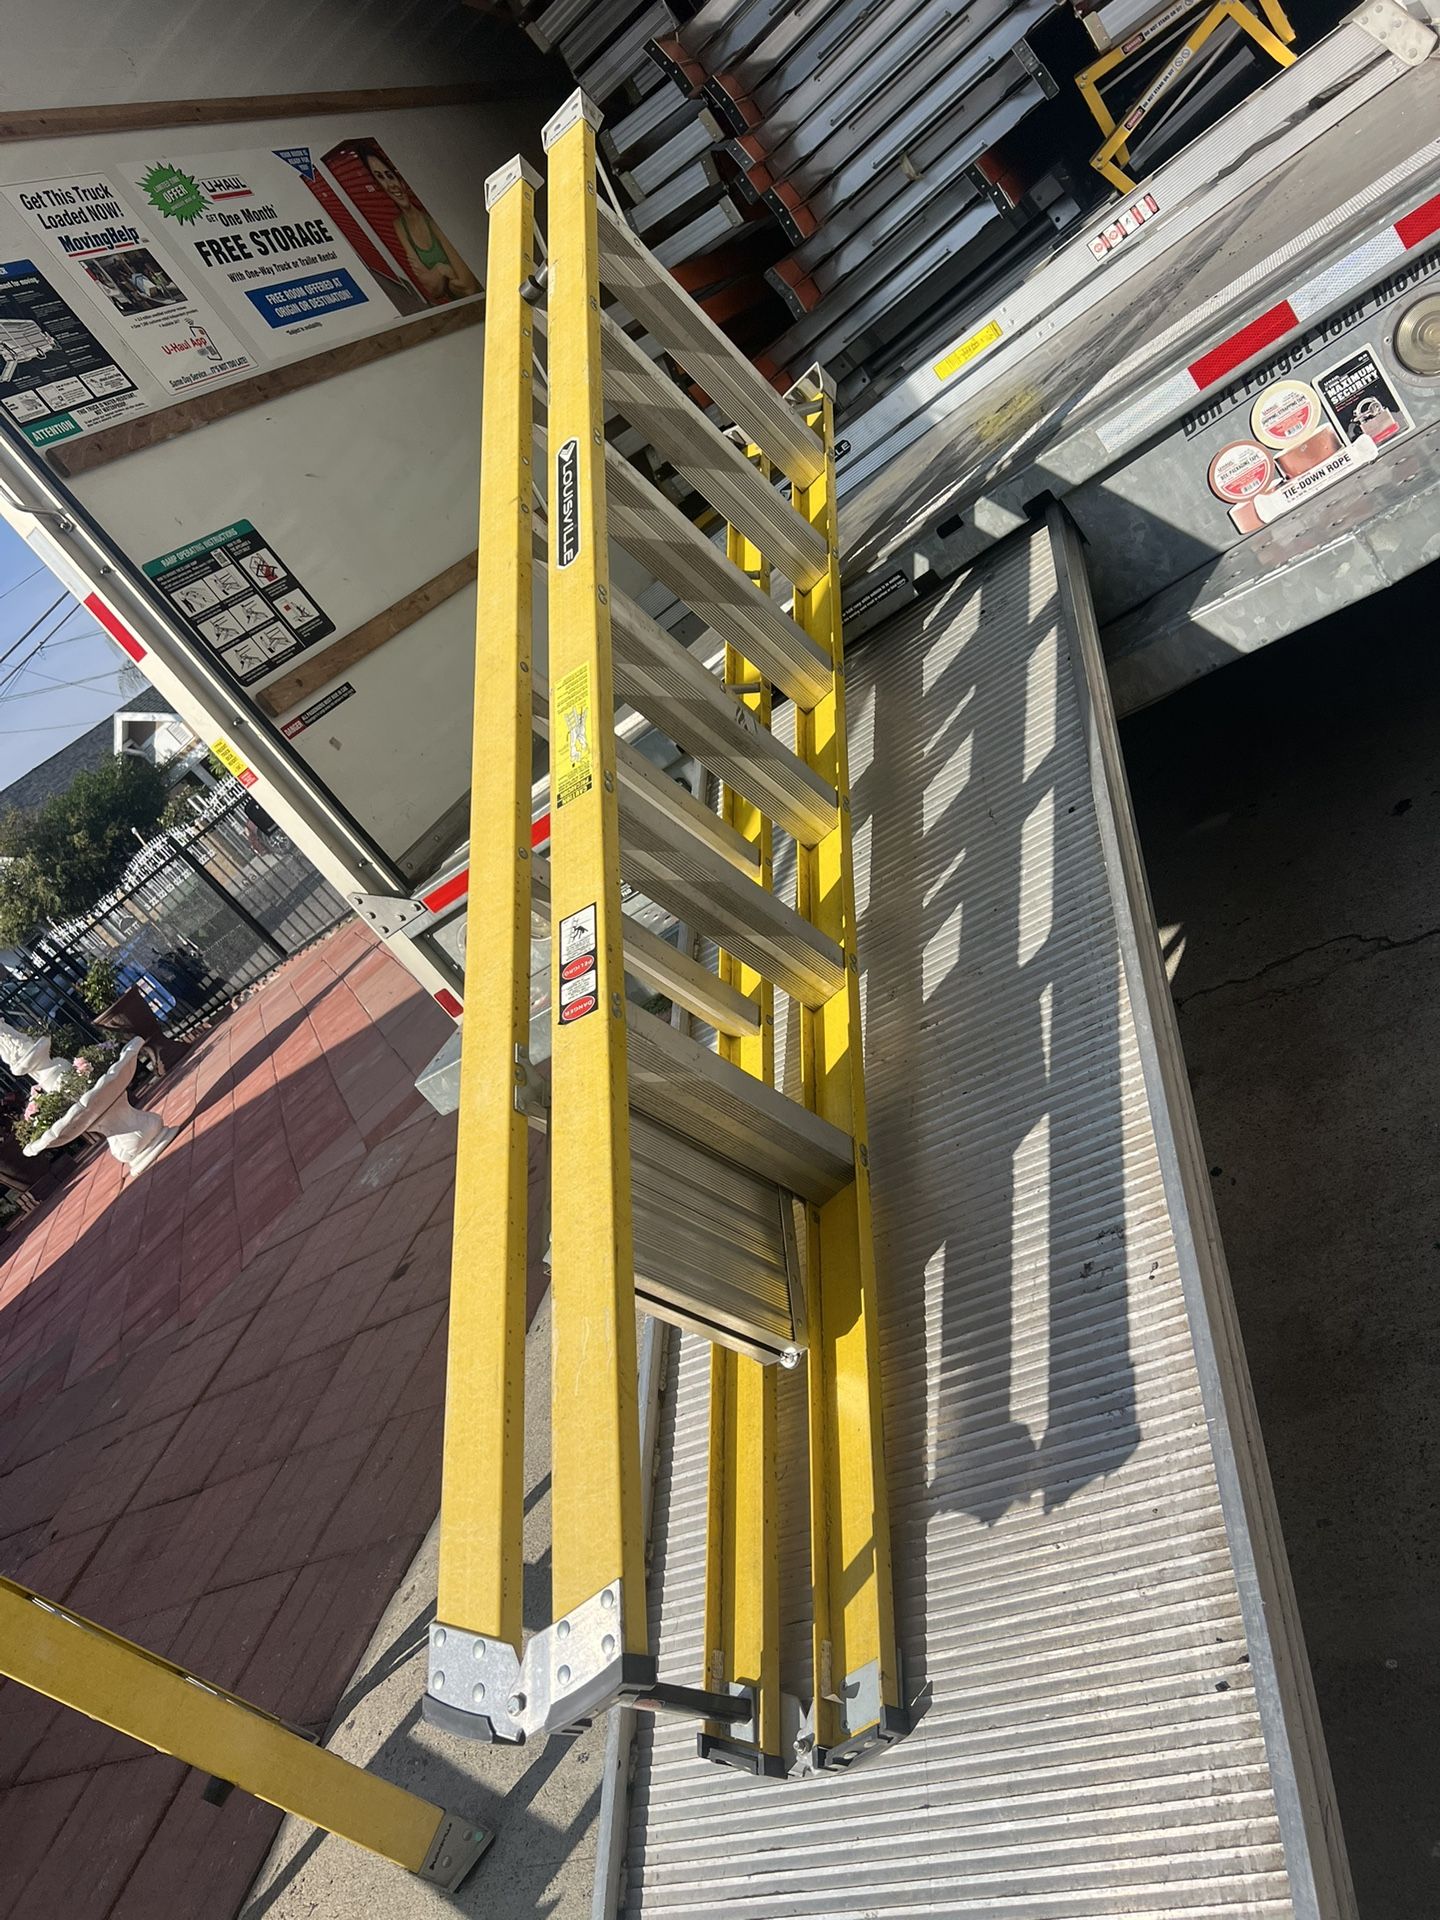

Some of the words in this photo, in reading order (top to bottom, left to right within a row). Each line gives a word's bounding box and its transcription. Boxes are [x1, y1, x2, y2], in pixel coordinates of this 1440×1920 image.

[20, 192, 47, 210] Get
[42, 188, 76, 206] This
[72, 183, 114, 202] Truck
[162, 184, 188, 203] OFFER
[202, 177, 247, 194] U-HAUL
[37, 207, 90, 230] Loaded
[86, 202, 124, 221] NOW!
[206, 214, 218, 223] GET
[218, 212, 241, 228] One
[58, 225, 140, 251] MovingHelp
[194, 234, 254, 268] FREE
[249, 219, 334, 256] STORAGE
[227, 272, 245, 283] With
[245, 264, 276, 279] One-Way
[274, 261, 292, 274] Truck
[292, 260, 300, 268] or
[298, 254, 318, 267] Trailer
[318, 251, 338, 264] Rental
[266, 290, 286, 305] FREE
[284, 286, 306, 302] ROOM
[304, 280, 336, 299] OFFERED
[332, 277, 344, 288] AT
[274, 302, 301, 318] ORIGIN
[298, 299, 310, 312] OR
[161, 340, 192, 355] U-Haul
[190, 336, 208, 348] App
[1181, 388, 1240, 437] Don't
[1241, 339, 1314, 396] Forget
[1316, 301, 1366, 343] Your
[1326, 363, 1376, 397] MAXIMUM
[1330, 371, 1380, 406] SECURITY
[32, 420, 75, 442] ATTENTION
[1282, 469, 1326, 500] TIE-DOWN
[1326, 454, 1350, 476] ROPE
[562, 460, 574, 565] LOUISVILLE
[160, 554, 178, 568] RAMP
[176, 542, 205, 561] OPERATING
[204, 528, 238, 549] INSTRUCTIONS
[284, 720, 304, 737] DANGER
[564, 959, 592, 977] PELIGRO
[564, 1000, 592, 1016] DANGER
